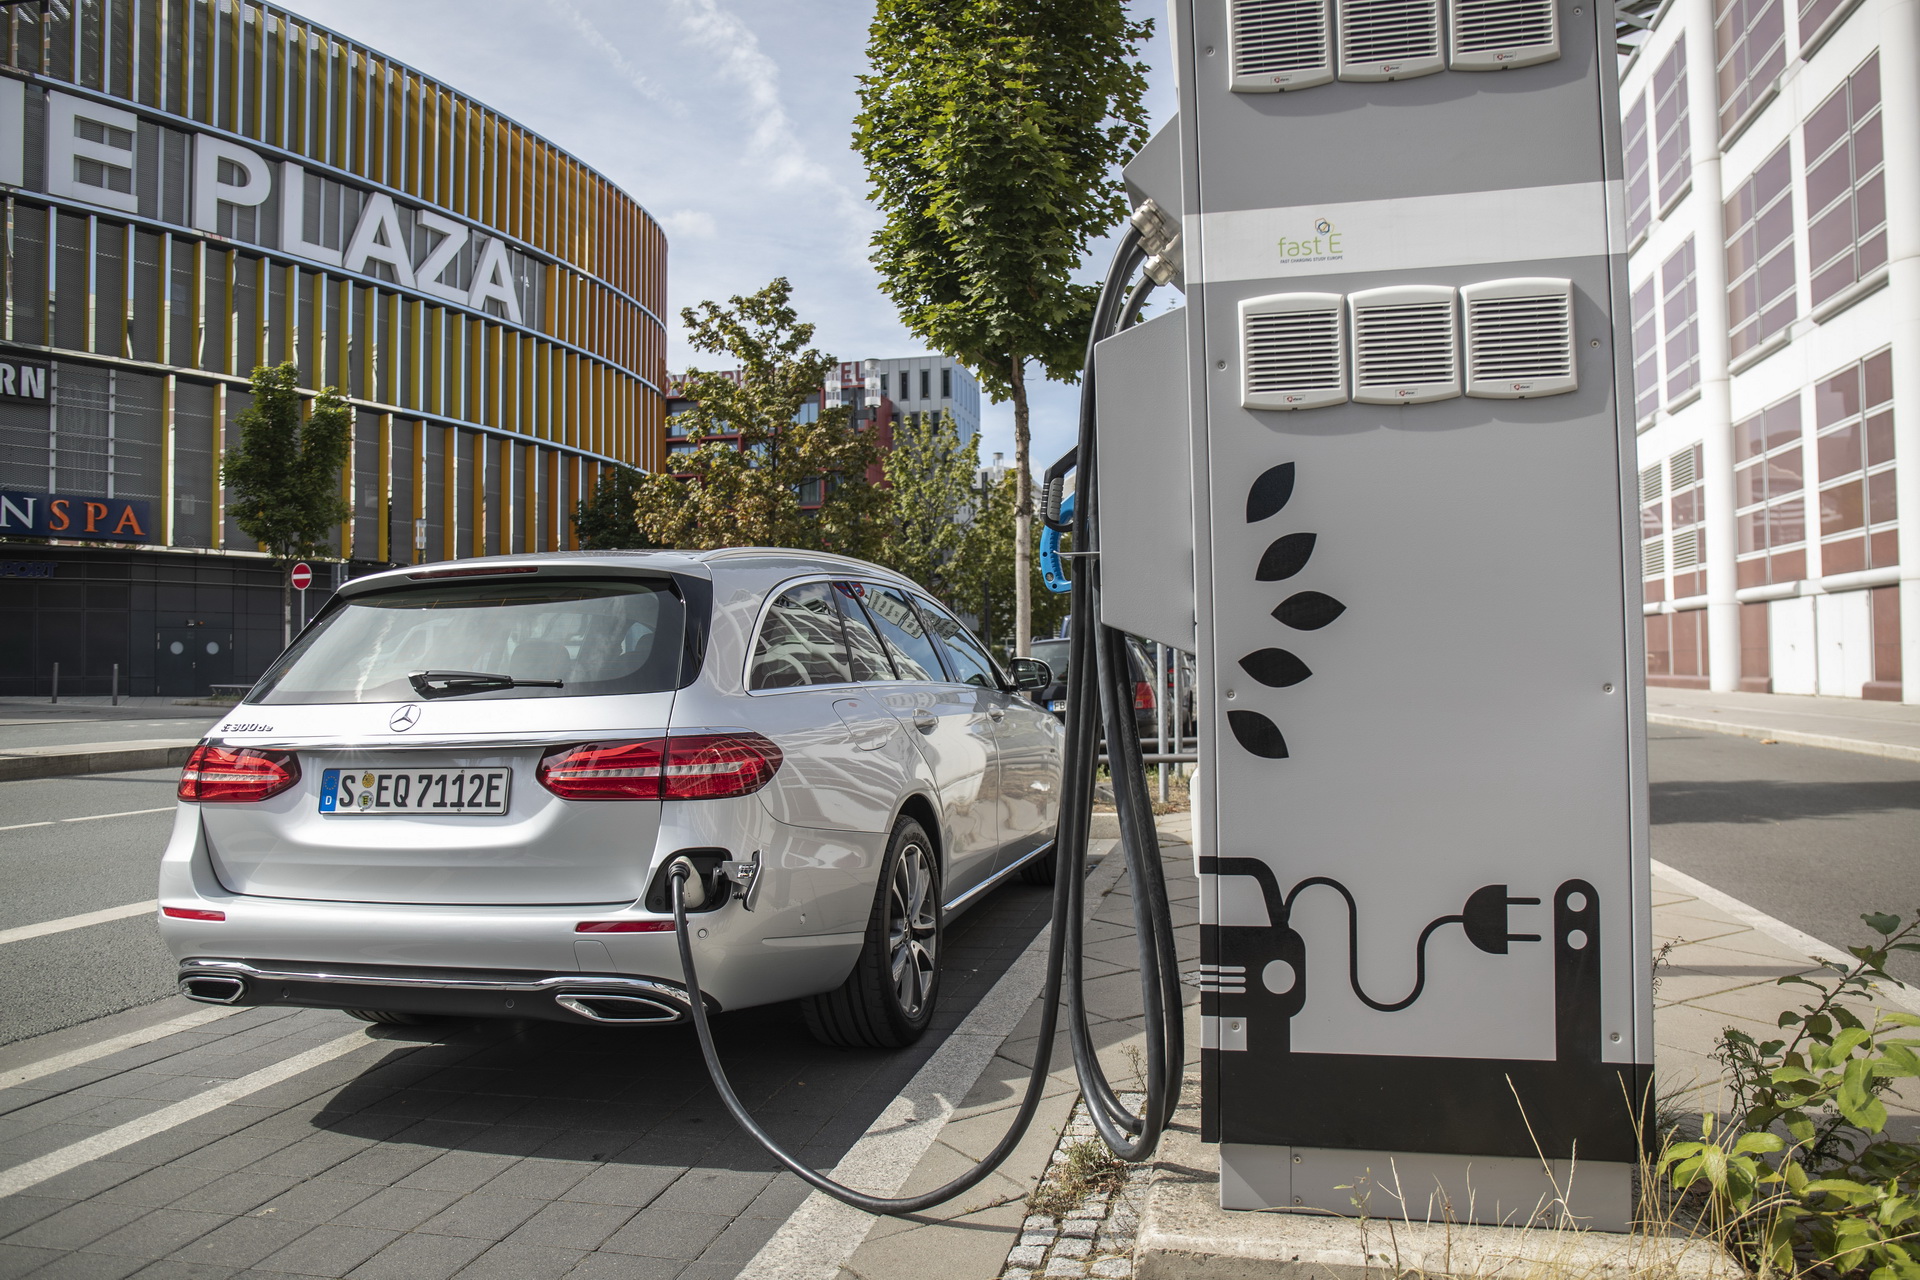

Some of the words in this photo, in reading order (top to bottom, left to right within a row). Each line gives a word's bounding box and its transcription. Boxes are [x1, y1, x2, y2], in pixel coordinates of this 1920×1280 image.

[191, 131, 523, 325] PLAZA
[1278, 237, 1322, 257] fast
[1329, 233, 1343, 253] E
[49, 499, 146, 536] SPA
[325, 795, 333, 806] D
[339, 774, 356, 808] S
[375, 774, 410, 808] EQ
[417, 773, 503, 808] 7112E
